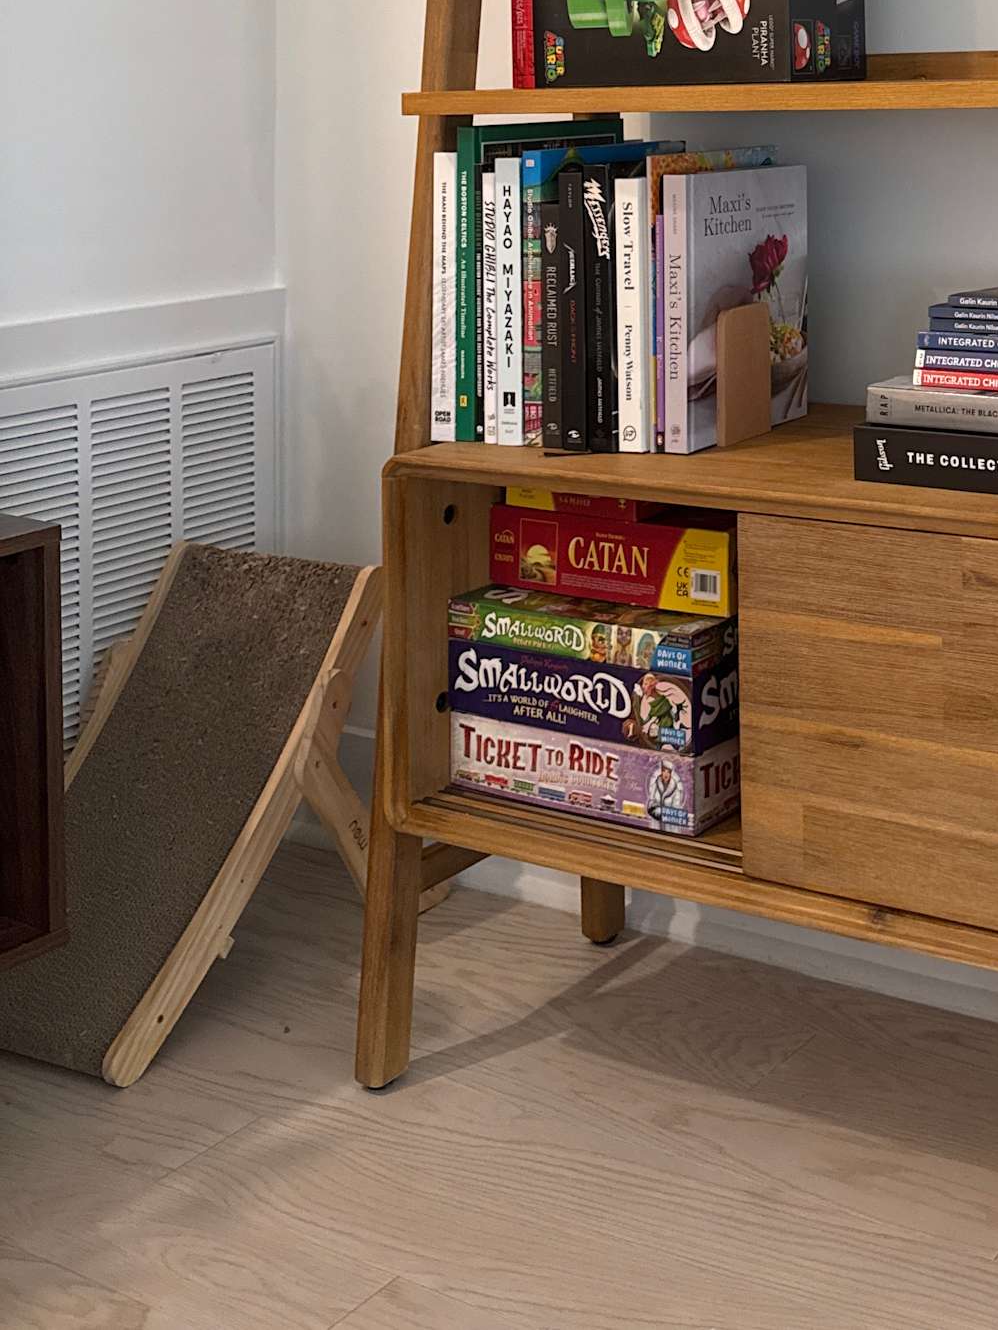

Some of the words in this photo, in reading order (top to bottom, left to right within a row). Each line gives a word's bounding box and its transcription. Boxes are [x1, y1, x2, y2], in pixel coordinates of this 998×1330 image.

[545, 31, 556, 82] MARIO
[555, 36, 565, 76] SUPER
[751, 27, 760, 60] PLANT
[759, 20, 769, 66] PIRANHA
[502, 185, 513, 250] HAYAO
[526, 188, 534, 214] Studio
[709, 193, 751, 215] Maxi's
[484, 201, 495, 240] STUDIO
[622, 201, 633, 237] Slow
[704, 215, 752, 237] Kitchen
[460, 258, 467, 270] An
[485, 244, 496, 283] GHIBLI
[526, 242, 534, 288] Architecture
[563, 242, 577, 294] METALLICA
[623, 241, 635, 290] Travel
[486, 287, 496, 304] The
[526, 291, 534, 299] in
[546, 266, 557, 319] RECLAIMED
[669, 254, 682, 309] Maxi's
[502, 263, 514, 368] MIYAZAKI
[977, 298, 997, 306] Kaurin
[485, 307, 496, 357] Complete
[526, 301, 534, 341] Animation
[546, 322, 557, 346] RUST
[623, 325, 633, 358] Penny
[669, 315, 682, 380] Kitchen
[937, 337, 995, 348] INTEGRATED
[485, 360, 496, 391] Works
[926, 355, 982, 367] INTEGRATED
[548, 368, 557, 402] HETFIELD
[624, 361, 633, 401] Watson
[923, 374, 980, 386] INTEGRATED
[962, 408, 976, 416] THE
[876, 438, 894, 471] Gibson
[906, 451, 935, 465] THE
[568, 536, 650, 578] CATAN
[657, 650, 676, 659] DAYS
[676, 651, 687, 660] OF
[657, 660, 688, 670] WONDER
[503, 694, 509, 703] A
[510, 695, 537, 706] WORLD
[538, 697, 549, 708] OF
[513, 705, 544, 720] AFTER
[545, 711, 567, 725] ALL!
[459, 723, 542, 772] TICKET
[545, 748, 564, 767] TO
[568, 742, 619, 781] RIDE
